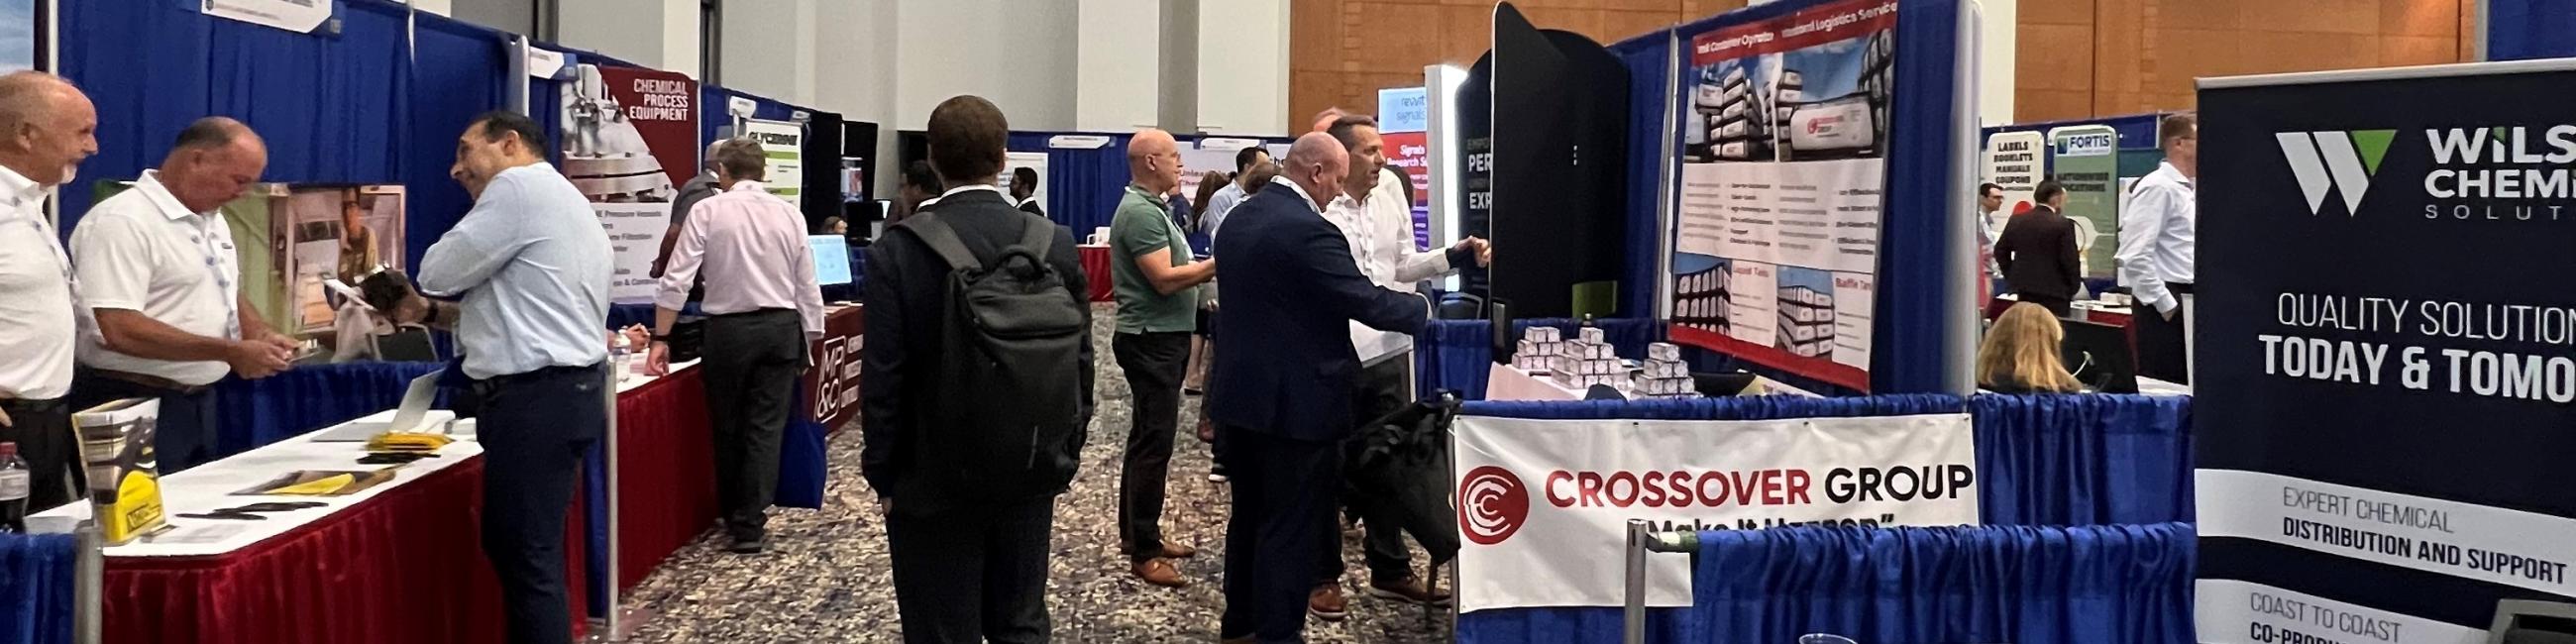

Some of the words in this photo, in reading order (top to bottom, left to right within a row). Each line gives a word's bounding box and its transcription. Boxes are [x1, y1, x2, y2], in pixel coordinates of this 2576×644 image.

[634, 78, 688, 95] CHEMICAL
[643, 93, 688, 108] PROCESS
[629, 106, 688, 121] EQUIPMENT
[1997, 141, 2028, 152] LABELS
[2070, 136, 2109, 148] FORTIS
[2279, 292, 2409, 333] QUALITY
[2259, 334, 2389, 385] TODAY
[2402, 346, 2430, 389] &
[1545, 470, 1812, 508] CROSSOVER
[1824, 464, 1974, 501] GROUP
[2283, 486, 2351, 516] EXPERT
[2356, 498, 2455, 533] CHEMICAL
[2283, 516, 2412, 558] DISTRIBUTION
[2417, 541, 2460, 566] AND
[2467, 549, 2567, 585] SUPPORT
[2250, 591, 2306, 621] COAST
[2311, 604, 2334, 629] TO
[2339, 611, 2402, 643] COAST
